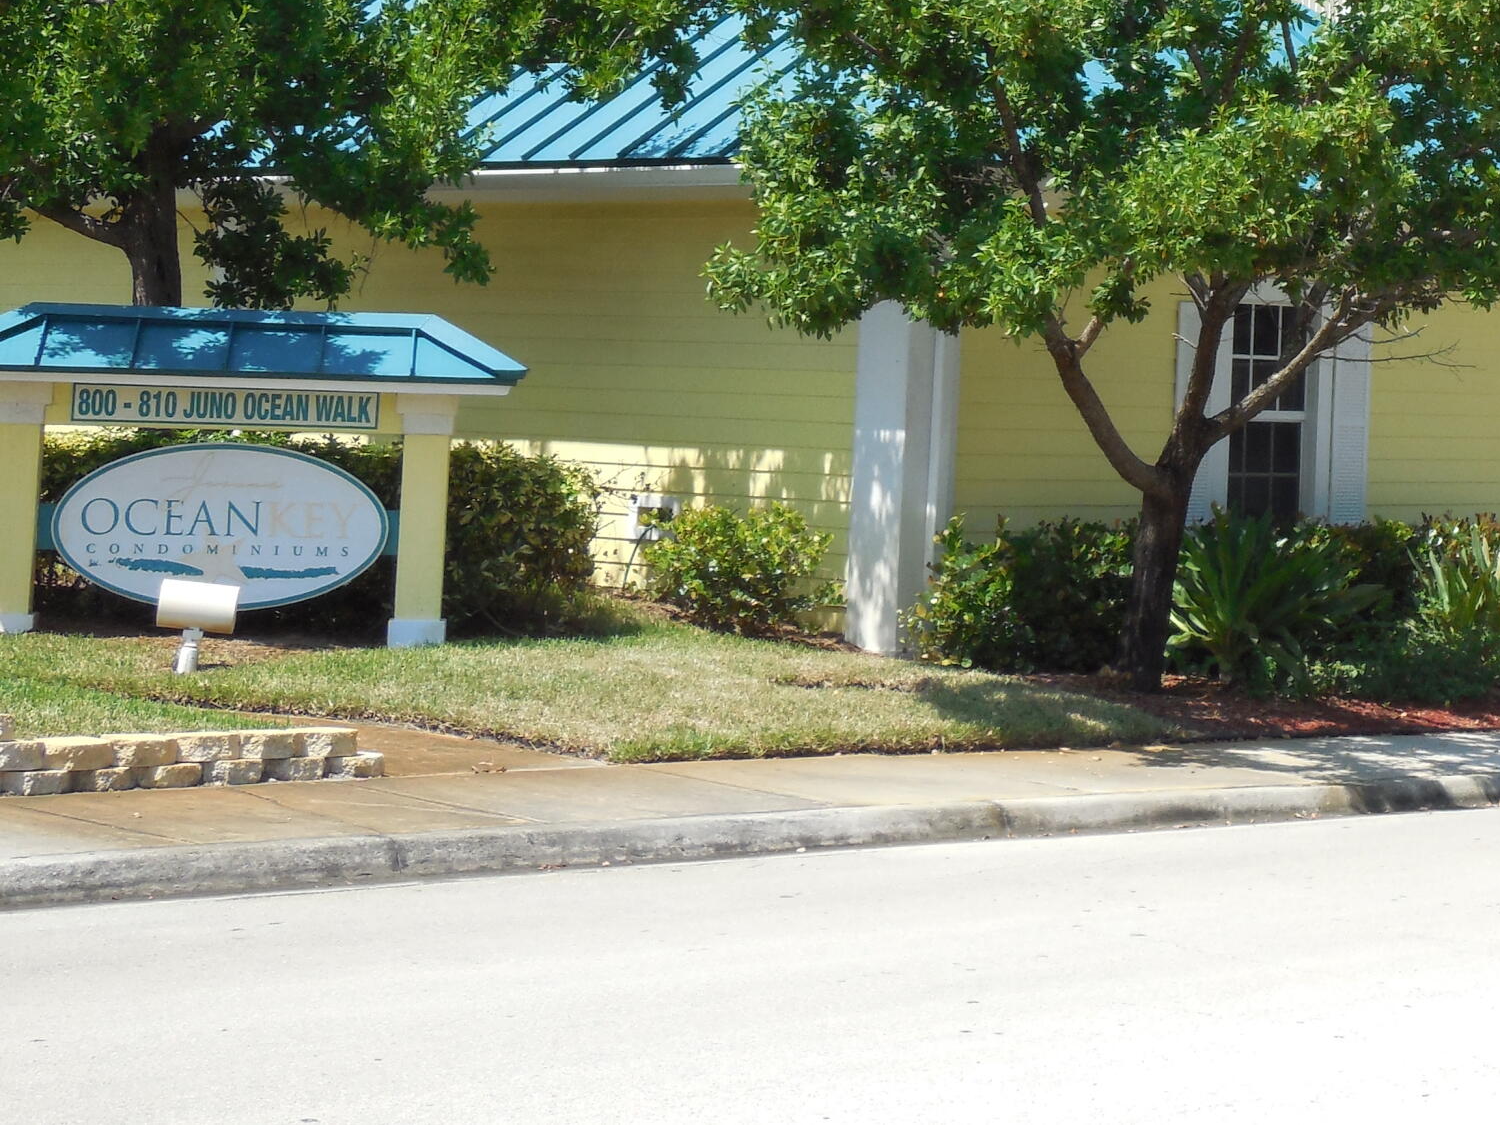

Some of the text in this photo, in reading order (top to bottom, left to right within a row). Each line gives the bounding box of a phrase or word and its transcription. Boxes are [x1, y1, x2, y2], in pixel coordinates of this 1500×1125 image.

[78, 388, 117, 416] 800
[138, 390, 177, 418] 810
[183, 391, 237, 420] JUNO
[243, 392, 310, 421] OCEAN
[315, 394, 372, 423] WALK
[86, 543, 349, 557] CONDOMINIUMS
